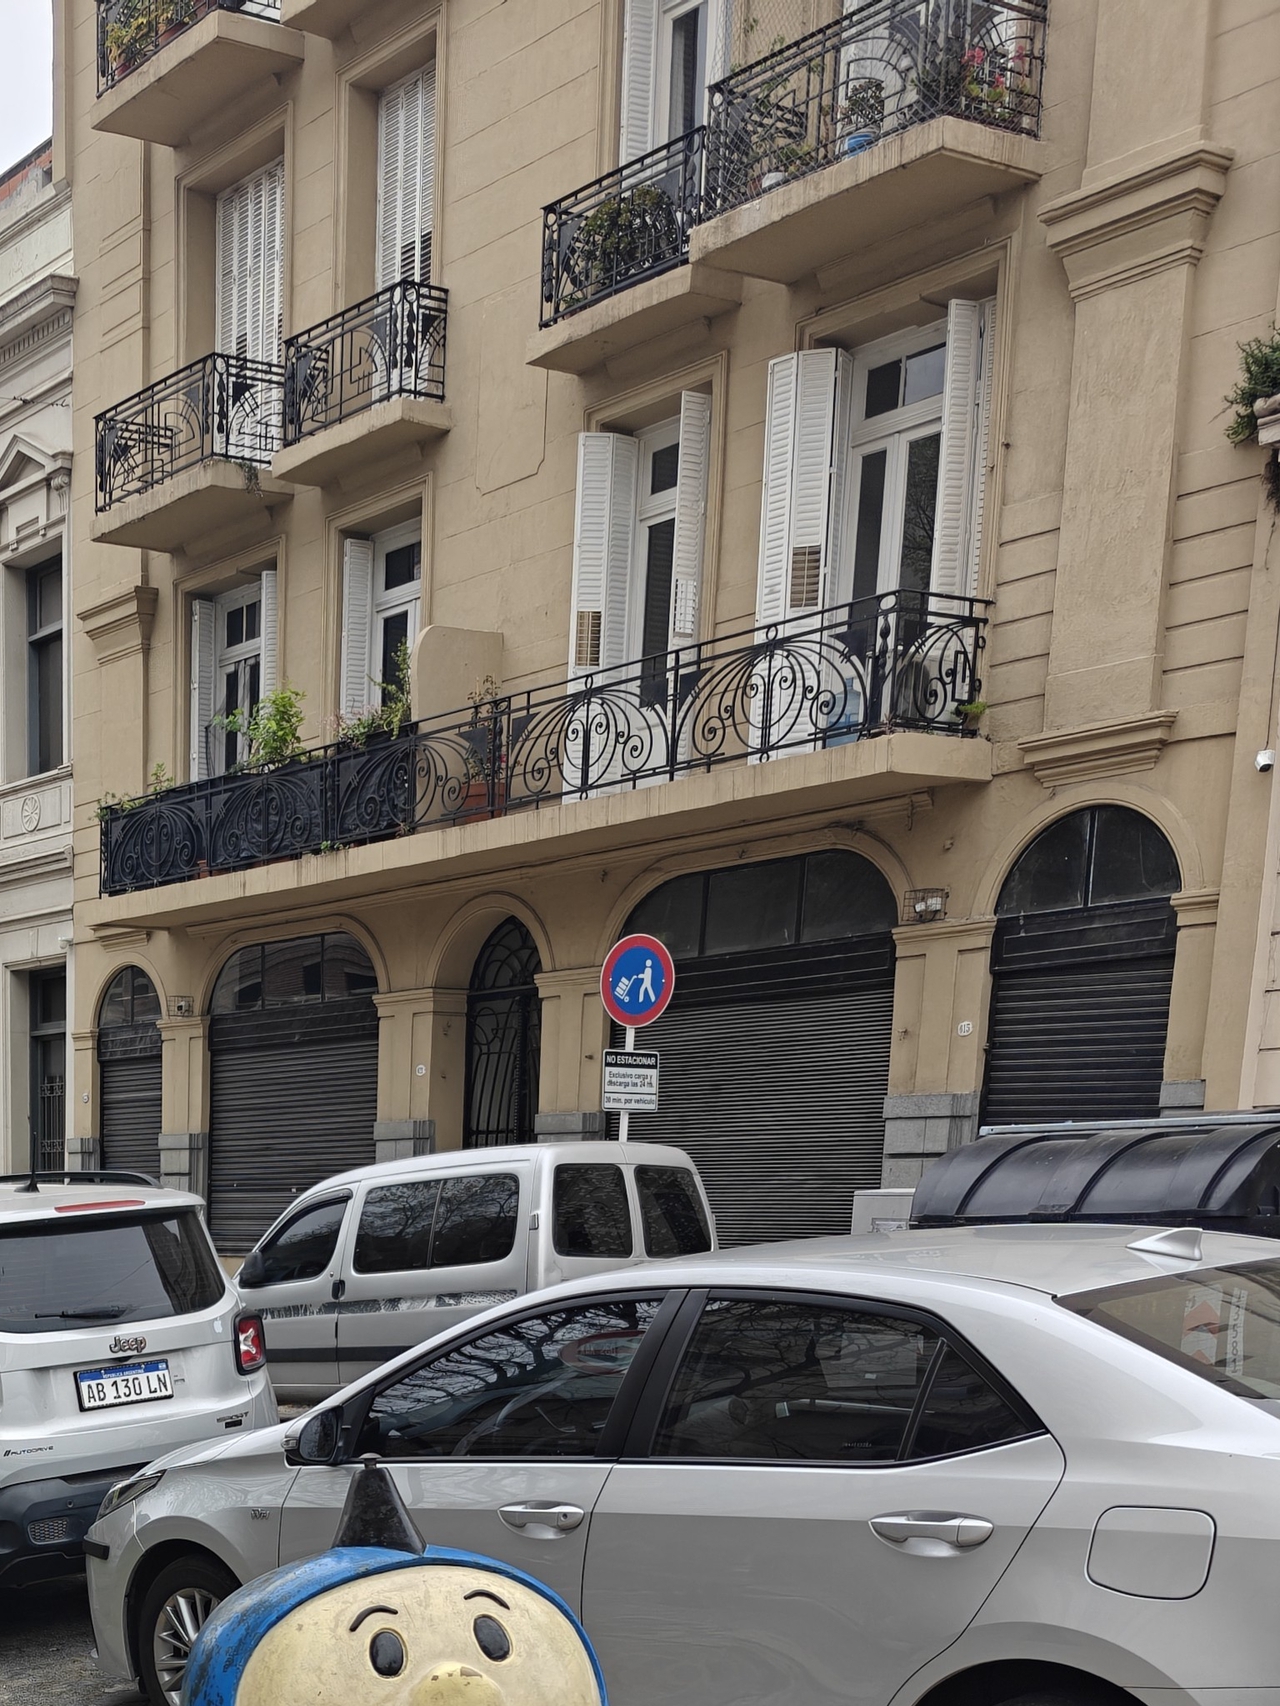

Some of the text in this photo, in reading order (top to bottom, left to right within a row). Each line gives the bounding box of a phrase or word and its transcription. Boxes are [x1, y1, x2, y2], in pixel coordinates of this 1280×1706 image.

[606, 1055, 656, 1065] NO ESTACIONAR
[609, 1071, 633, 1079] Exclusivo
[634, 1073, 649, 1081] carga
[607, 1079, 630, 1088] descarga
[109, 1336, 147, 1353] Jeep
[87, 1373, 168, 1403] AB 130 LN
